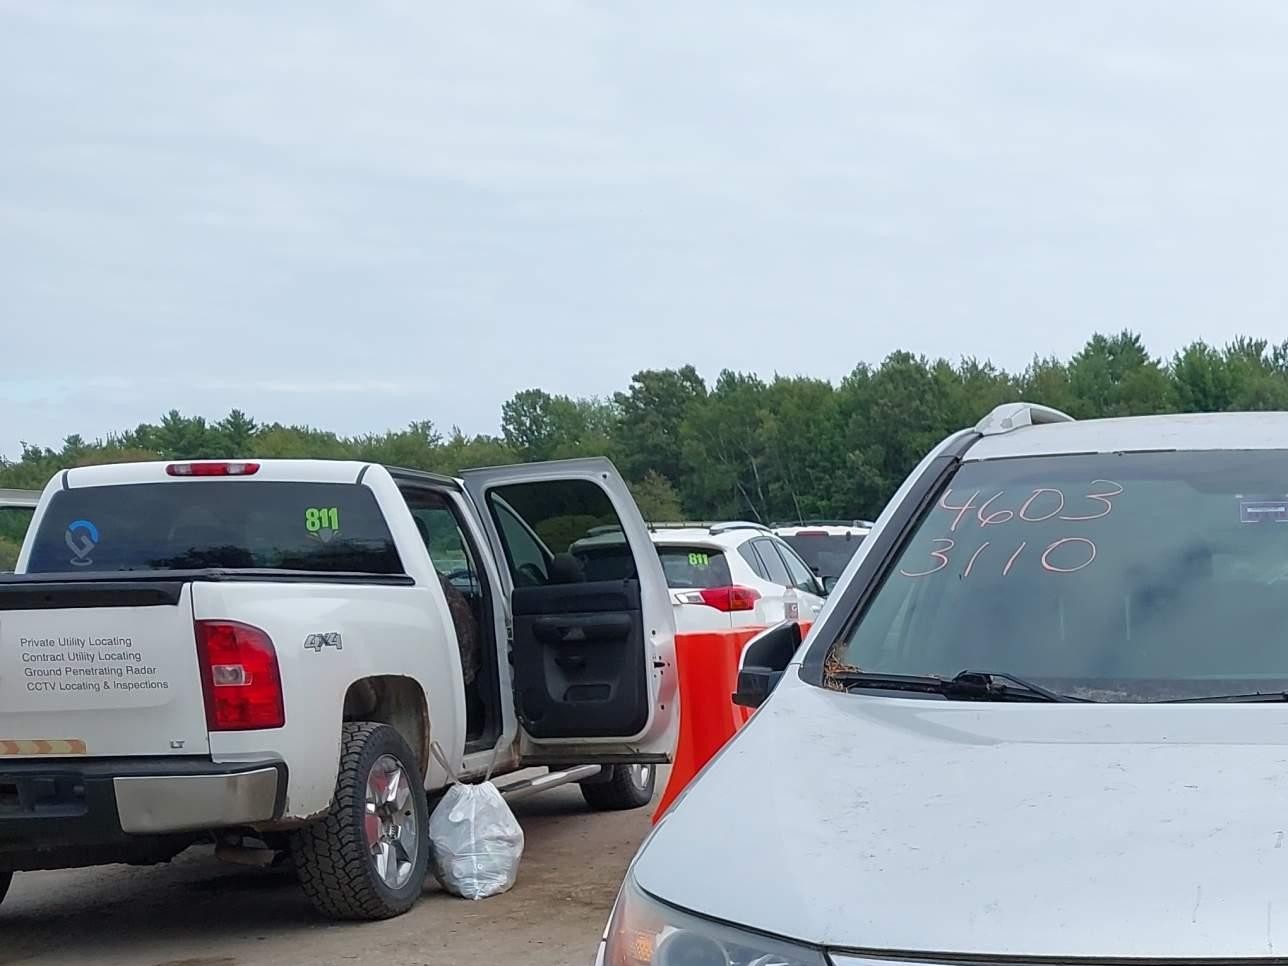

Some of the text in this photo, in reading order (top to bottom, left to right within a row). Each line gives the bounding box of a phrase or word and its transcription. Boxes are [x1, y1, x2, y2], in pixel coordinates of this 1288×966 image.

[940, 480, 1123, 531] 4603
[305, 507, 339, 531] 811
[688, 553, 709, 566] 811
[901, 537, 1096, 577] 3110
[20, 636, 132, 648] Private Utility Locating
[22, 651, 142, 663] Contract Utility Locating
[24, 665, 157, 677] Ground Penetrating Radar
[27, 680, 169, 692] CCTV Locating & Inspections
